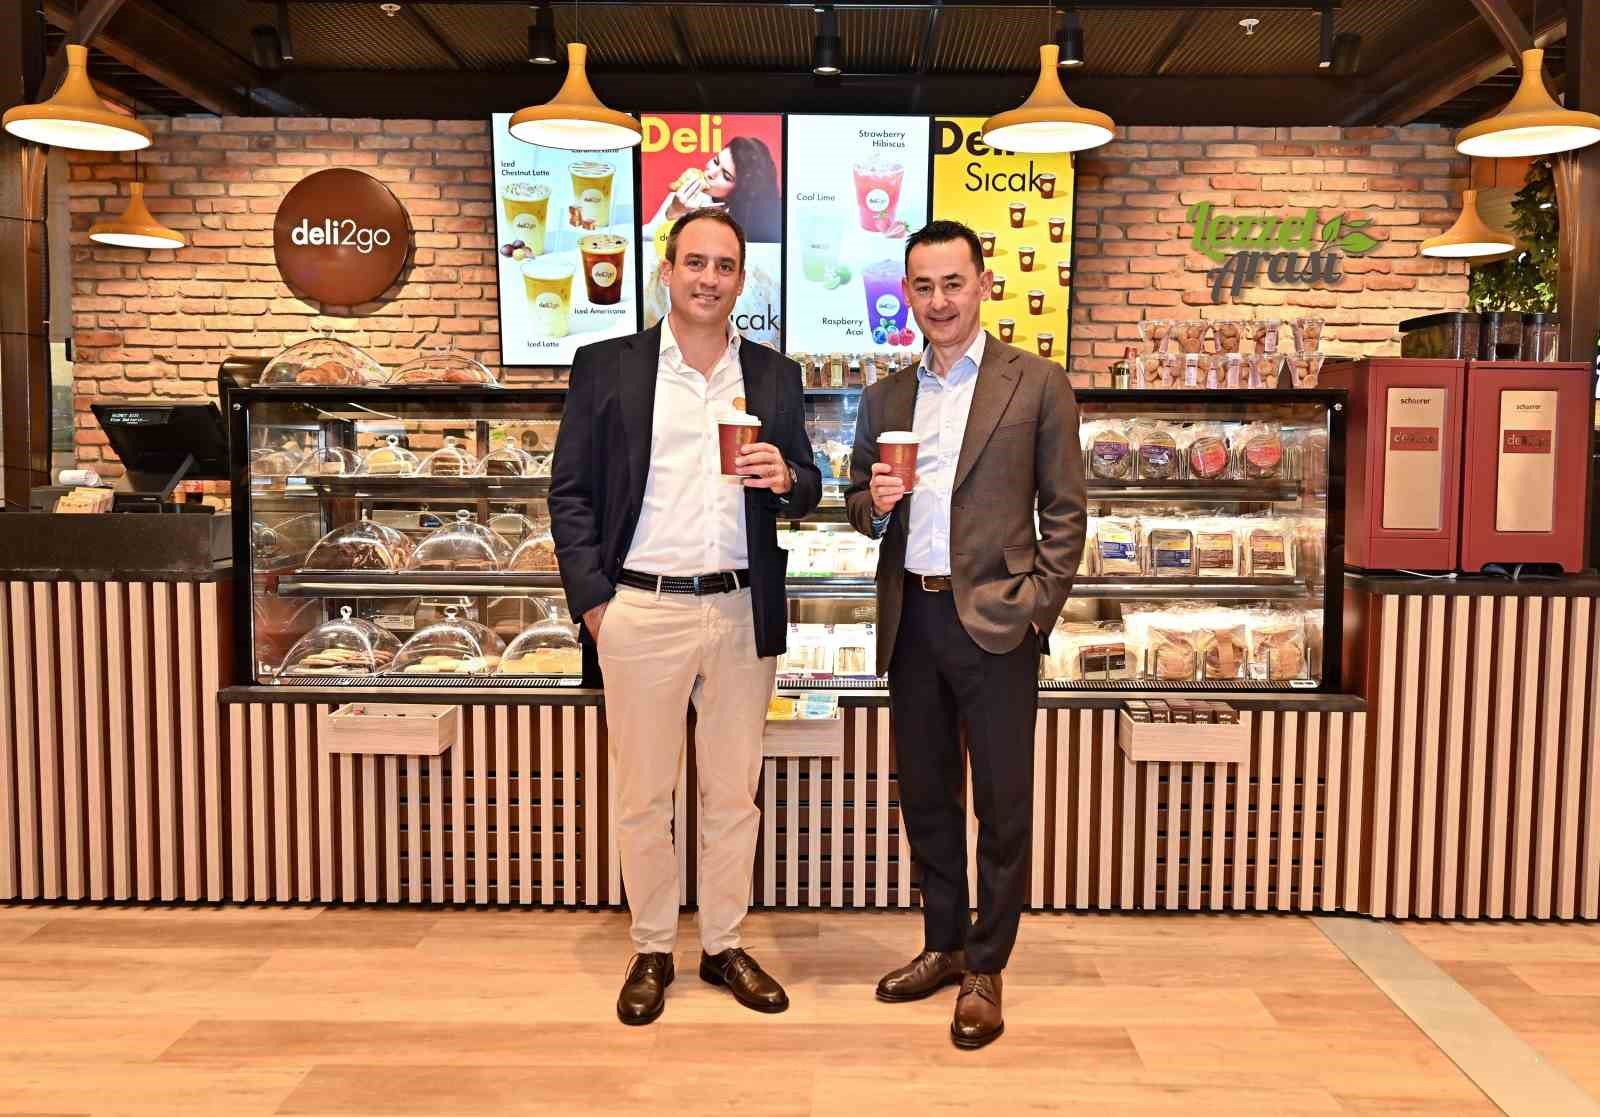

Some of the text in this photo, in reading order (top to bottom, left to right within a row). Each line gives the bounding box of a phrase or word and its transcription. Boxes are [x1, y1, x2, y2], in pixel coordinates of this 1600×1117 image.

[641, 114, 723, 154] Deli
[858, 129, 906, 140] Strawberry
[934, 120, 1015, 156] De
[872, 139, 905, 148] Hibiscus
[500, 160, 515, 168] Iced
[501, 169, 550, 177] Chestnut Latte
[796, 192, 836, 202] Cool Lime
[291, 218, 391, 254] deli2go
[1186, 200, 1320, 262] Lezzet
[574, 307, 626, 315] Iced Americano
[822, 317, 864, 327] Raspberry
[846, 328, 864, 336] Acai
[527, 340, 560, 348] Iced Latte
